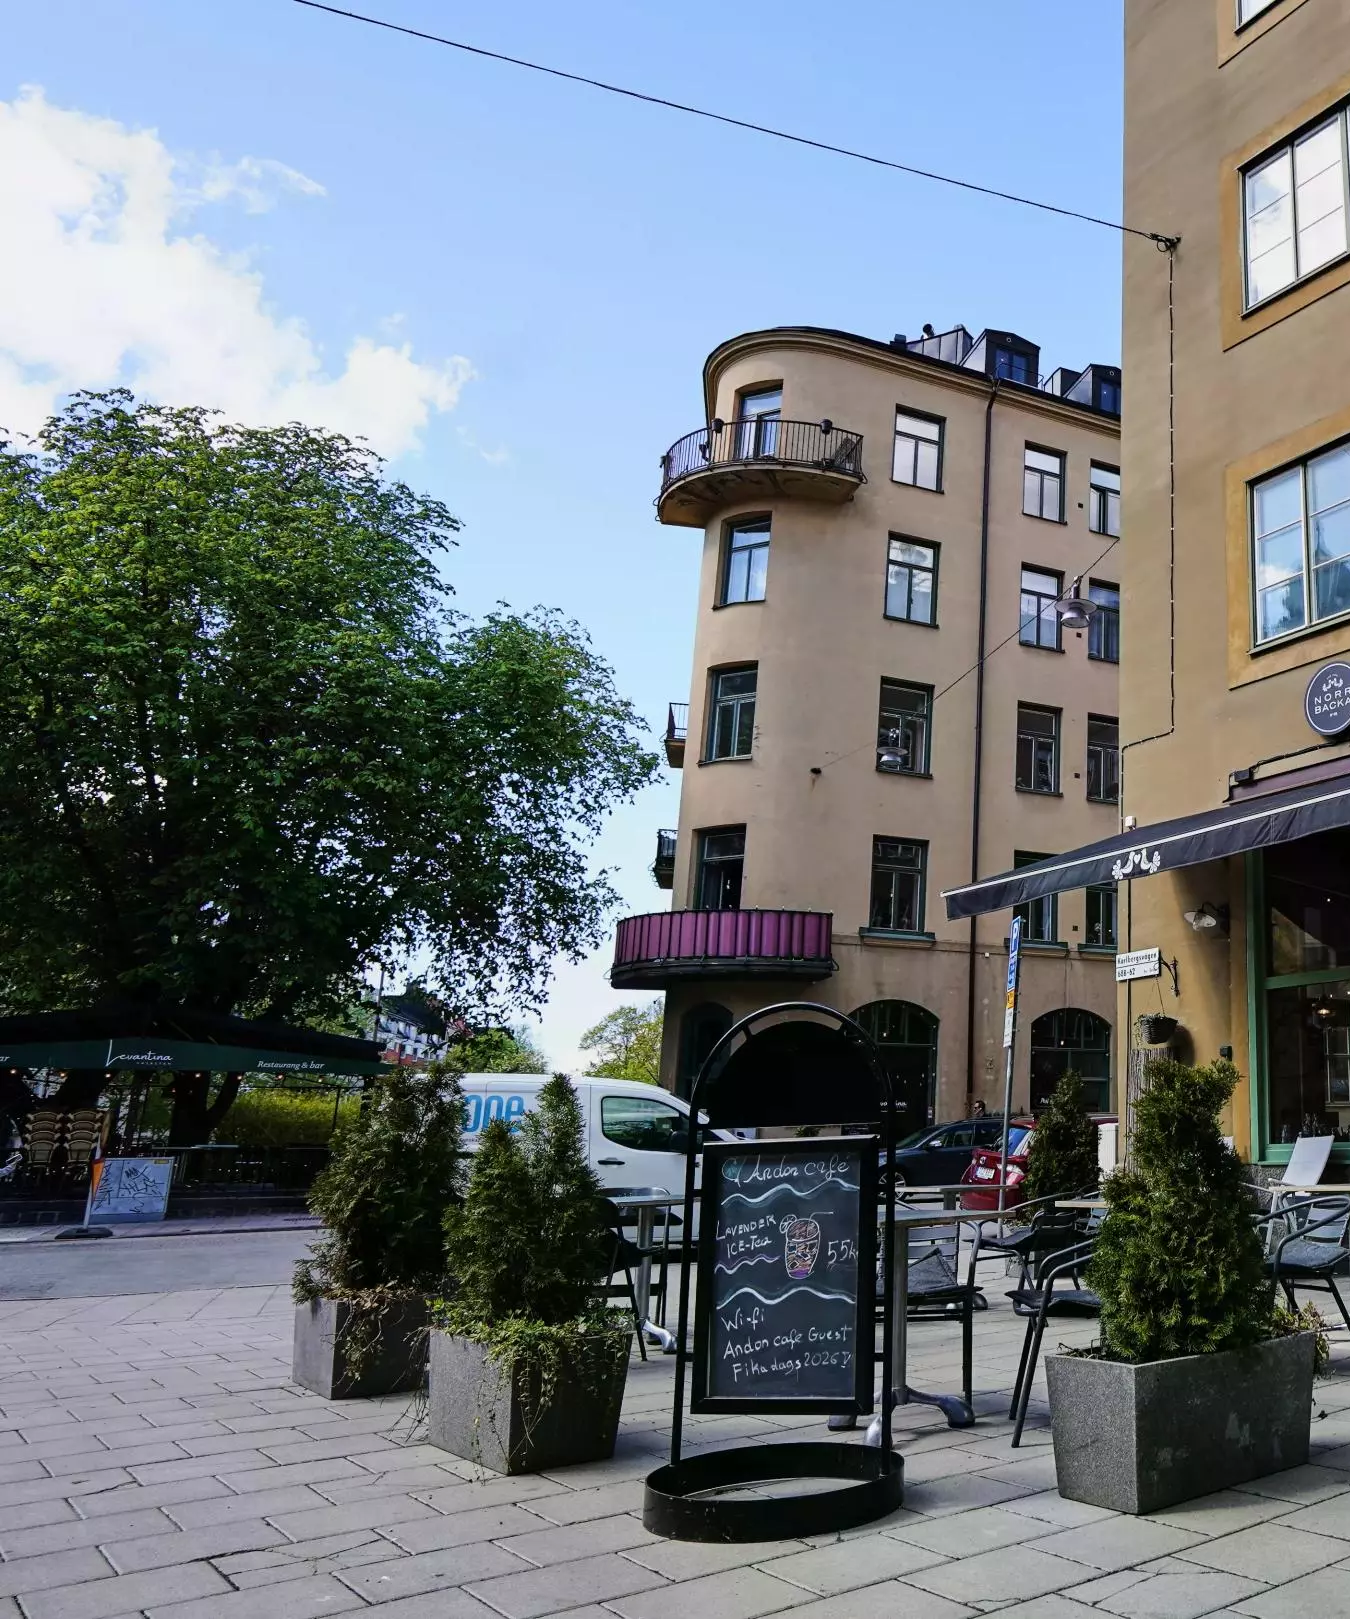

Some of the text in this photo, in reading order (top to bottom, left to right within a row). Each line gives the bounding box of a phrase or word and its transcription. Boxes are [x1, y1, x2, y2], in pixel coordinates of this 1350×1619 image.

[105, 1039, 173, 1067] Levantina
[257, 1060, 325, 1071] Restaurang & bar
[723, 1336, 769, 1360] Andon
[808, 1323, 853, 1342] Guest
